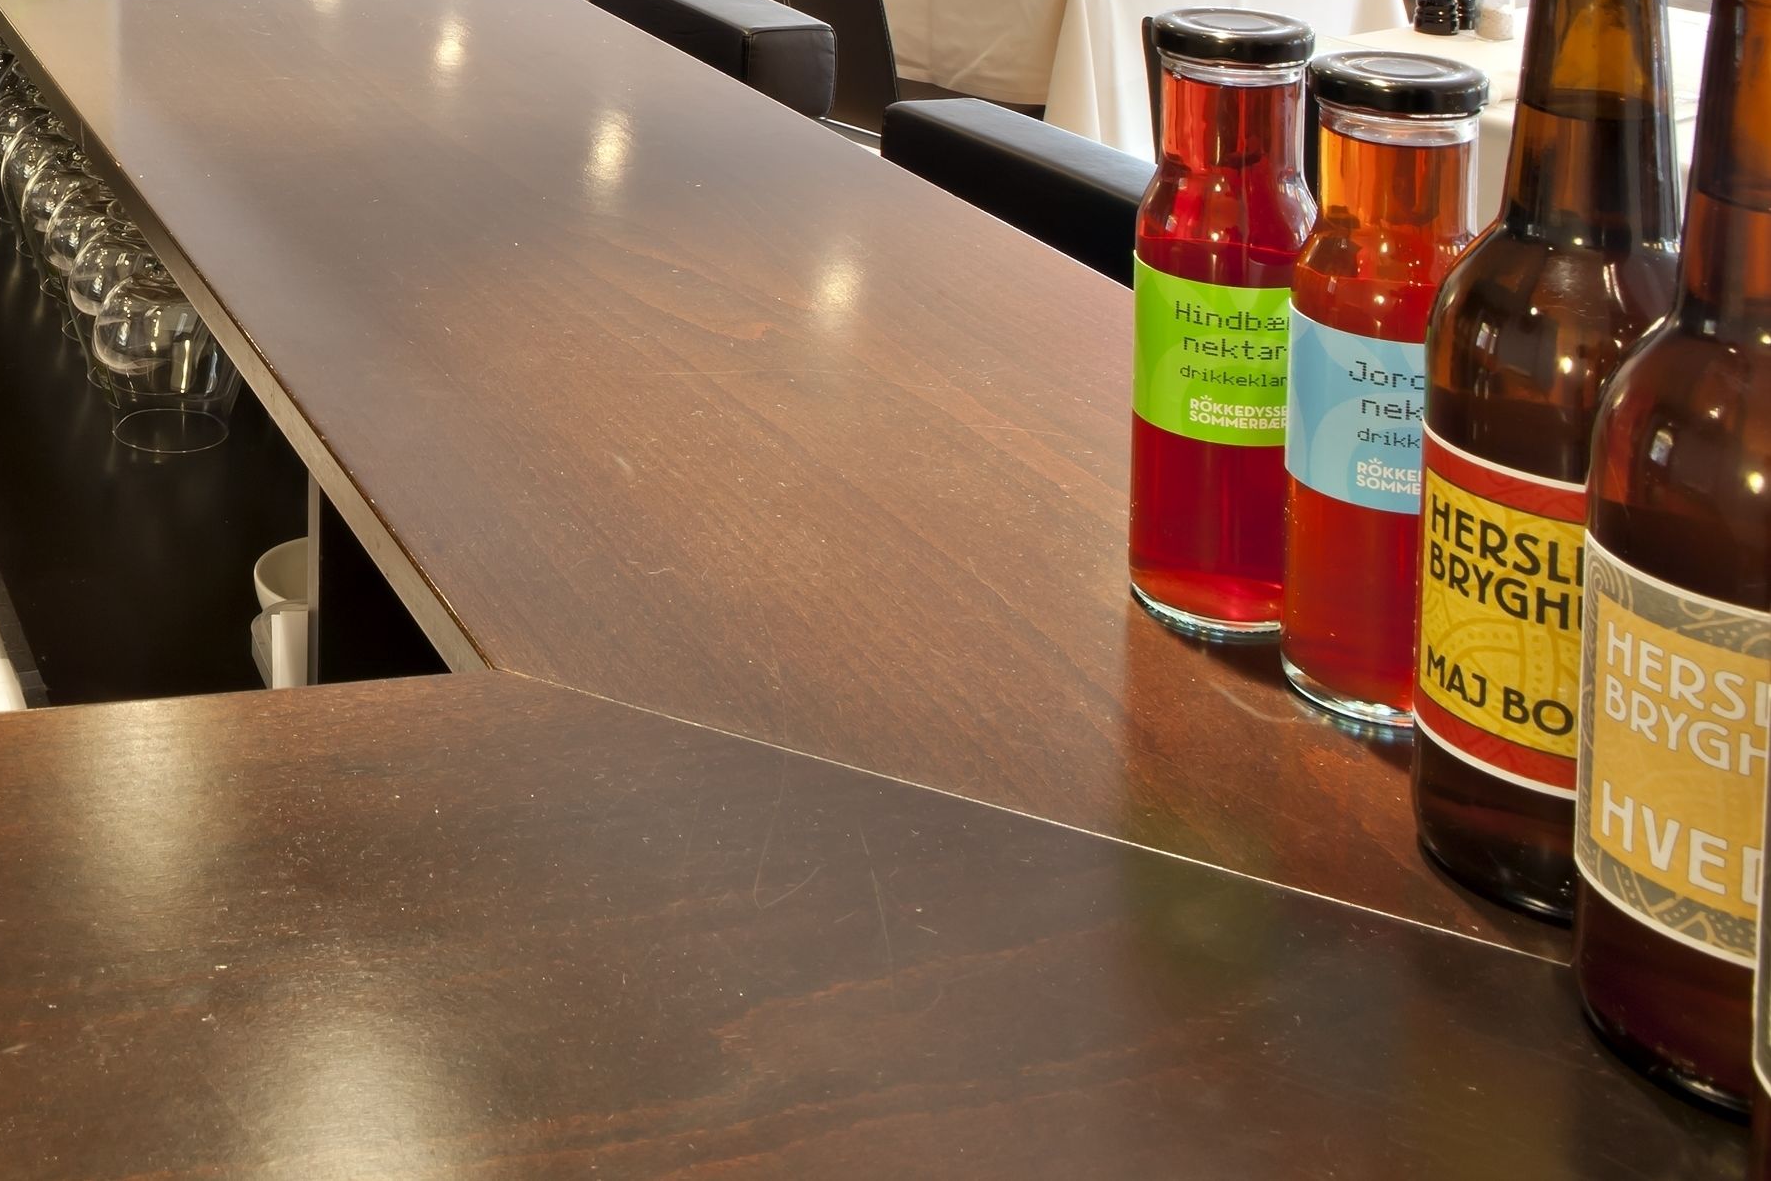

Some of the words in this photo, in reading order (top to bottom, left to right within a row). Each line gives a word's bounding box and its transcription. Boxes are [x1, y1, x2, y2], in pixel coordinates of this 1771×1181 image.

[1183, 336, 1288, 360] nektar
[1179, 364, 1287, 388] drikkeklar
[1357, 428, 1421, 449] drikk
[1429, 538, 1583, 631] BRYGH
[1427, 644, 1487, 708] MAJ
[1502, 685, 1574, 736] BO
